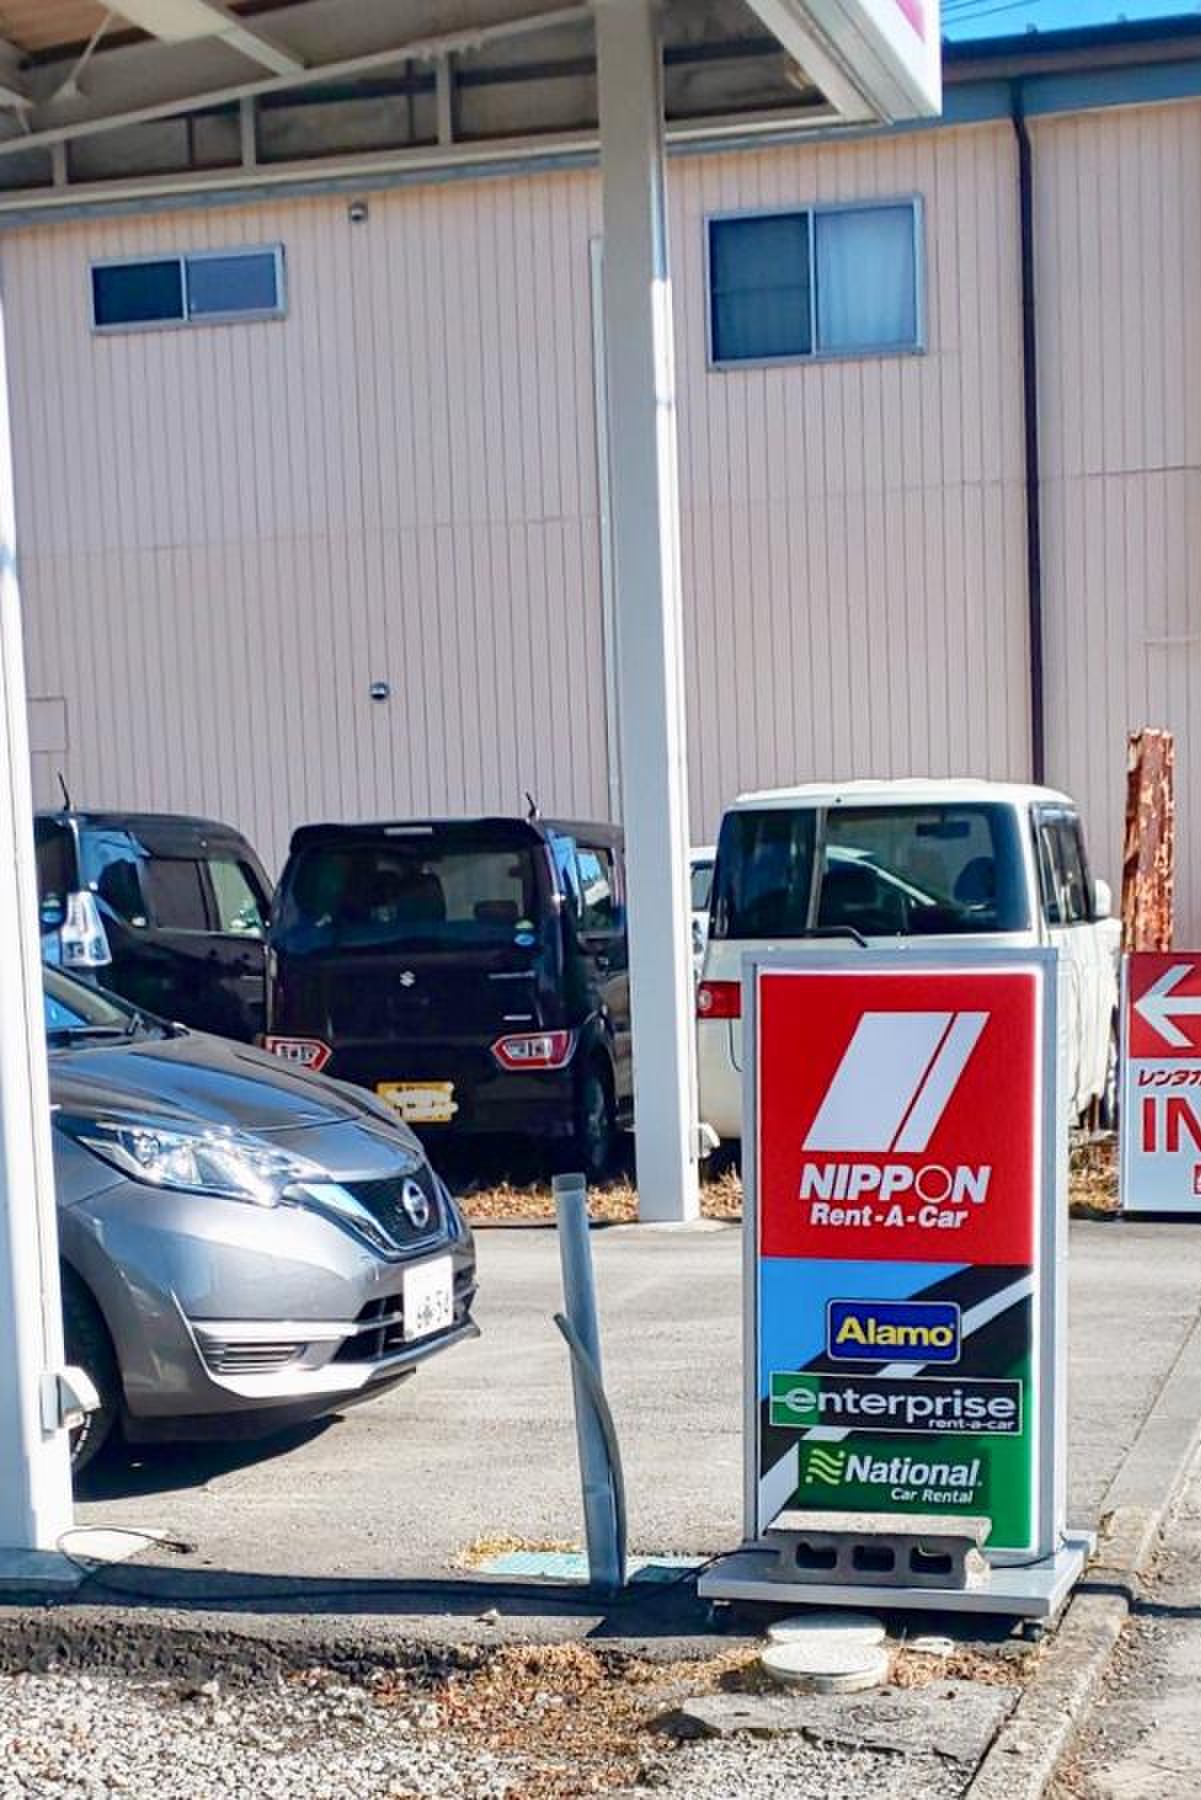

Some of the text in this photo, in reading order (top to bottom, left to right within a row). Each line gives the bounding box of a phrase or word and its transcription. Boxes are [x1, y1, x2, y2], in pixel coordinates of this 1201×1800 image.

[799, 1163, 992, 1203] NIPPON
[810, 1203, 969, 1229] Rent-A-Car
[835, 1316, 954, 1347] Alamo
[783, 1387, 1016, 1423] enterprise
[928, 1417, 1016, 1431] rent-a-car
[845, 1455, 981, 1487] National
[890, 1487, 974, 1504] Car Rental
